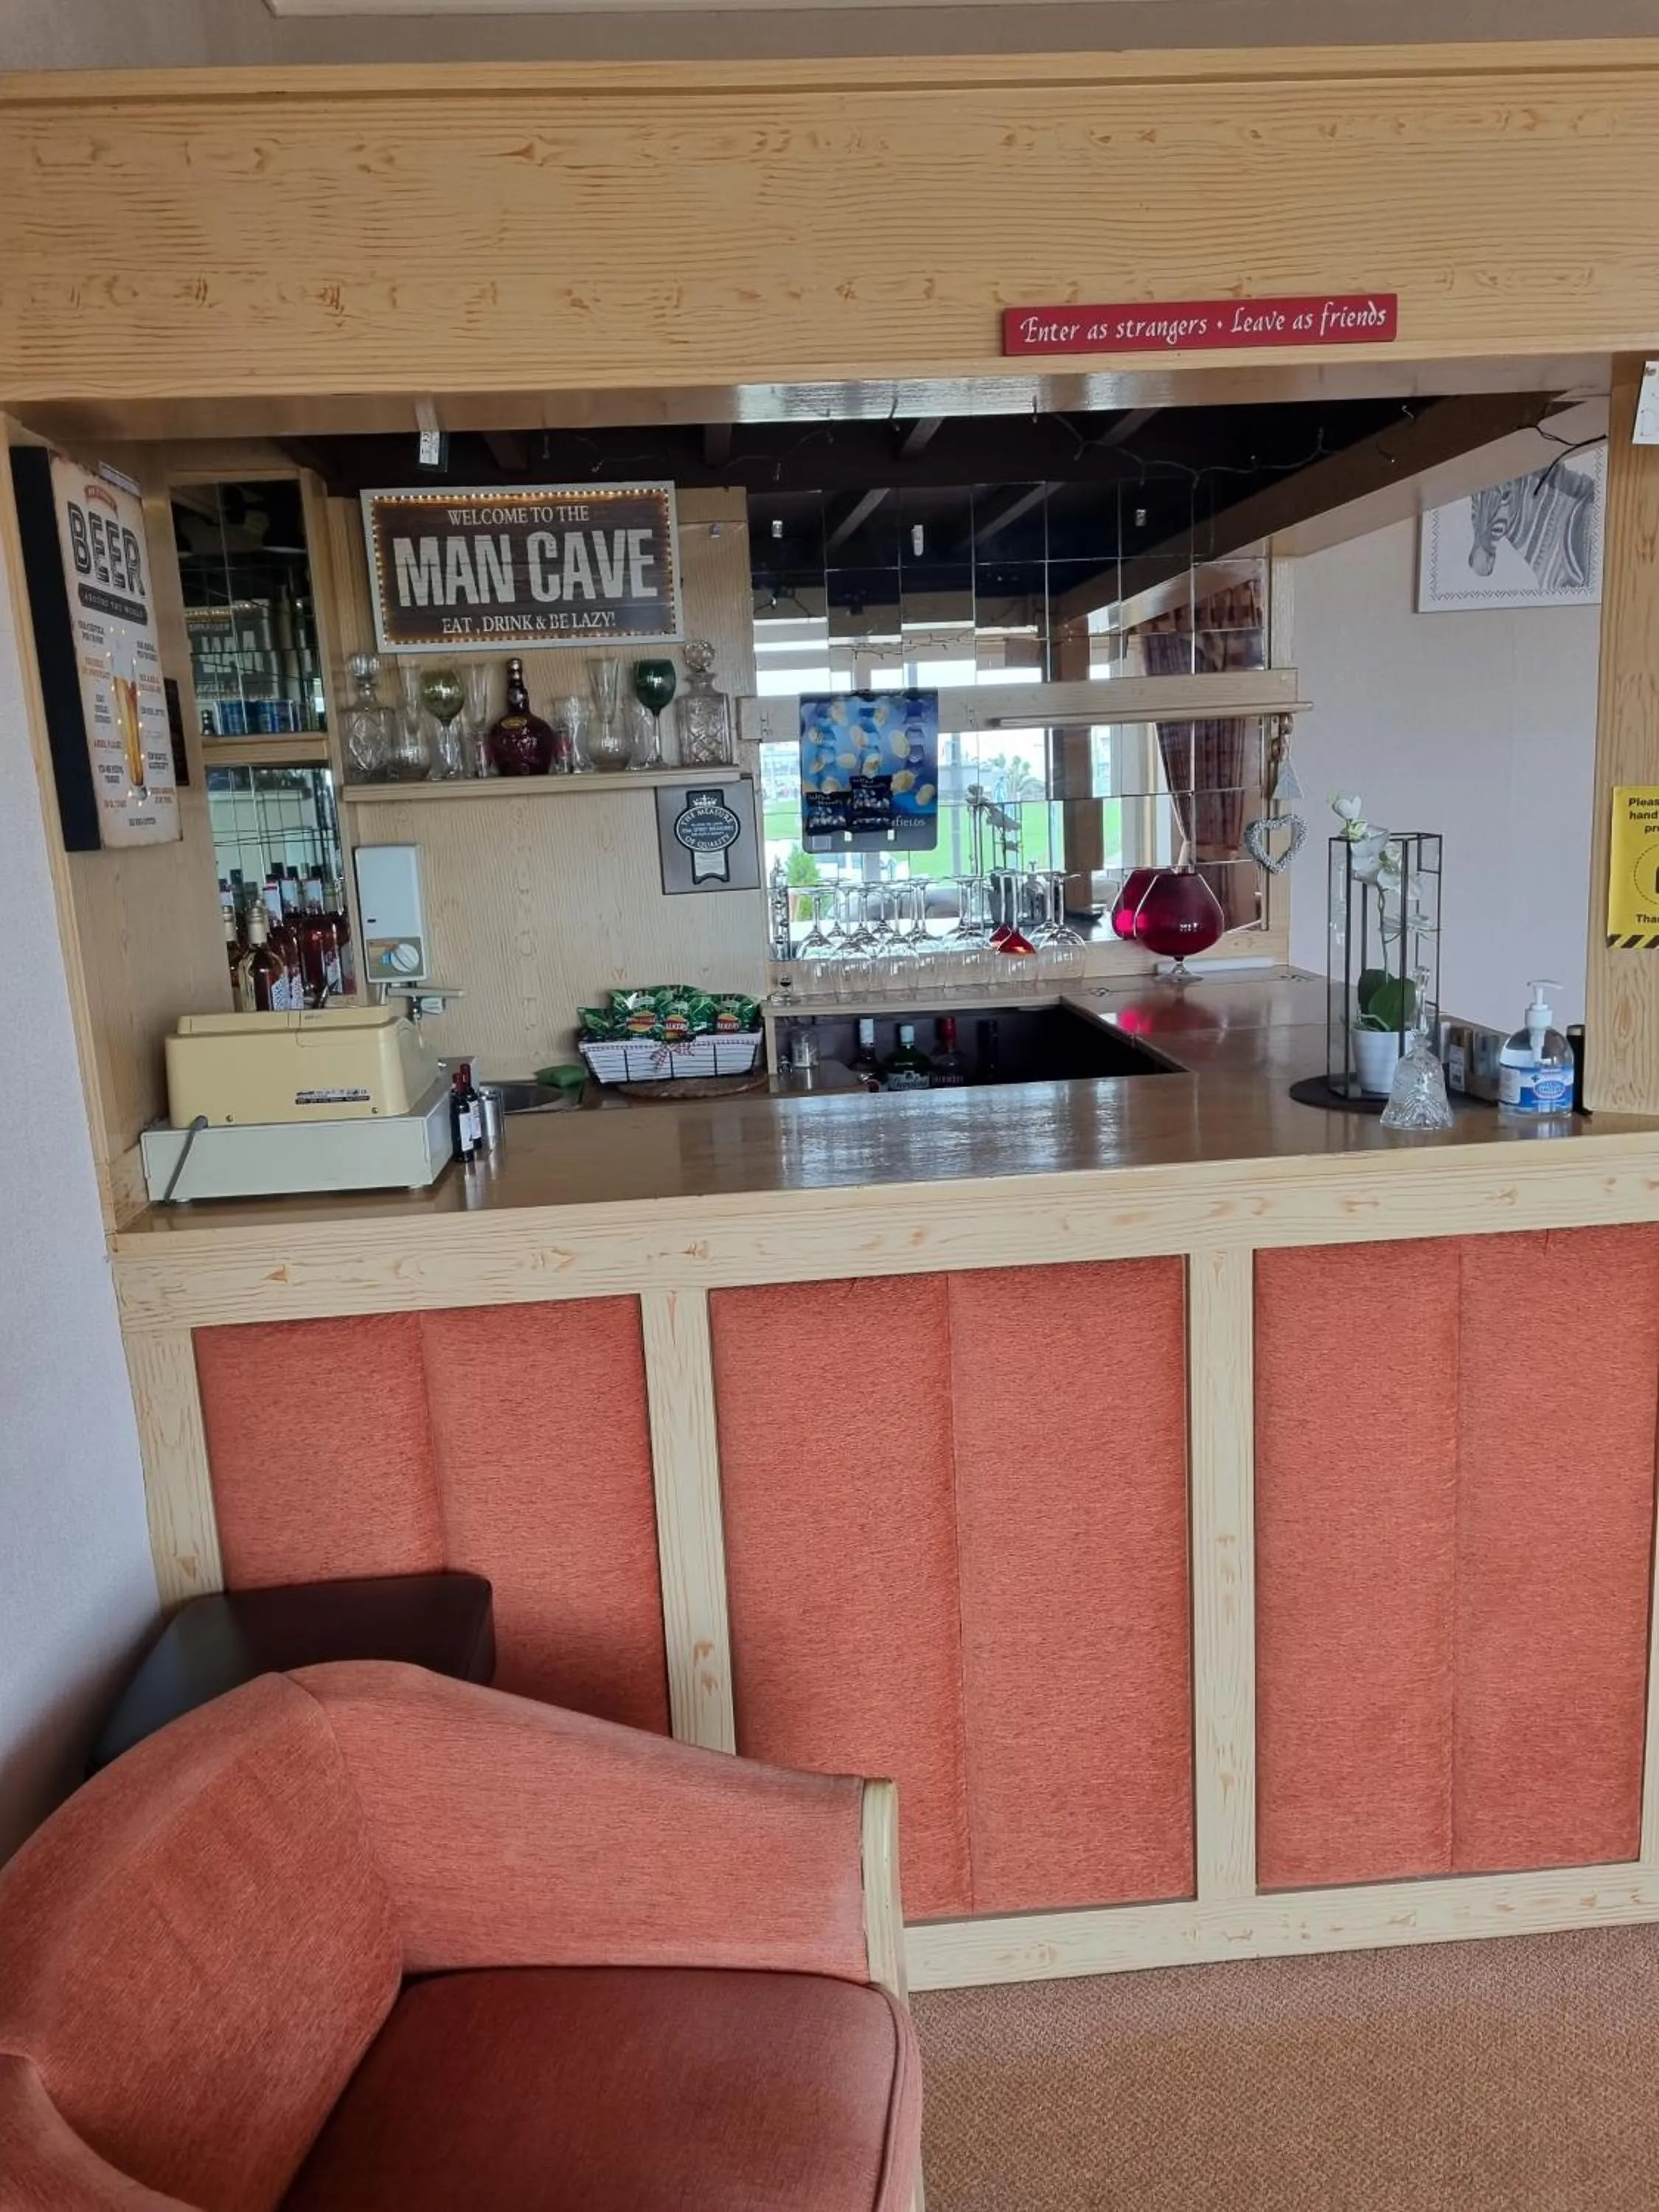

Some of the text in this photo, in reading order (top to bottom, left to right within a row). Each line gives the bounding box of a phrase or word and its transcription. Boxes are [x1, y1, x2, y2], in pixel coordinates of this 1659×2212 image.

[1020, 301, 1387, 344] Enter as strangers Leave as friends
[448, 505, 589, 526] WELCOME TO THE
[67, 501, 146, 597] BEER
[393, 529, 658, 608] MAN CAVE
[483, 614, 532, 633] DRINK
[536, 615, 546, 630] &
[549, 613, 568, 630] BE
[571, 611, 616, 629] LAZY!
[1629, 810, 1658, 820] hand
